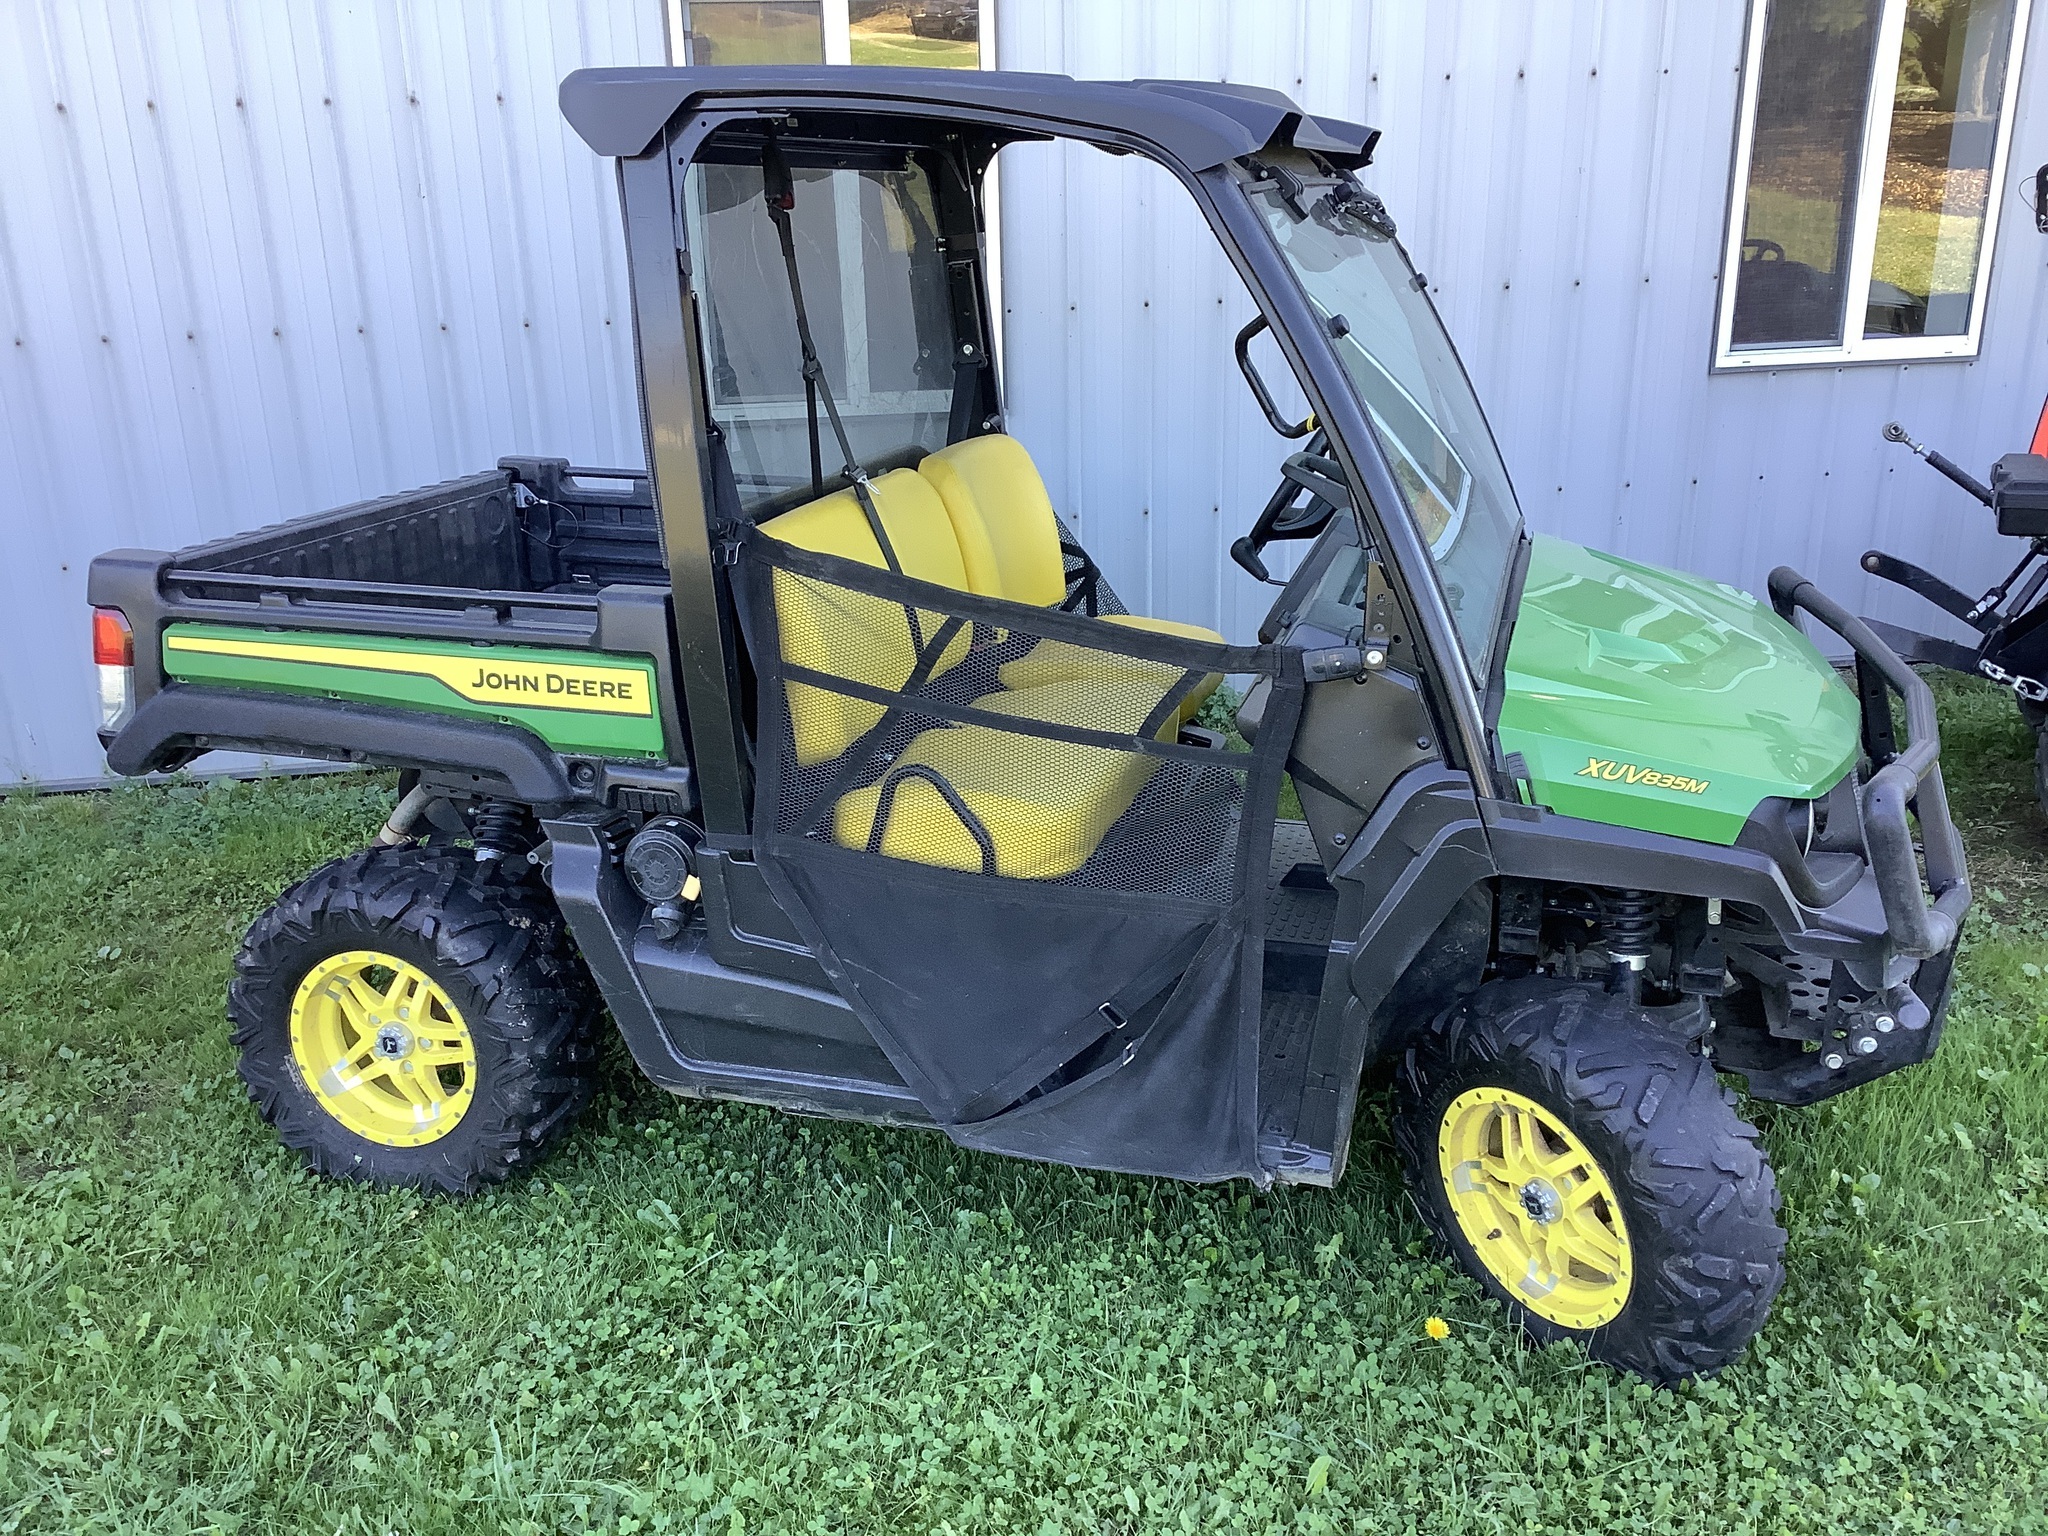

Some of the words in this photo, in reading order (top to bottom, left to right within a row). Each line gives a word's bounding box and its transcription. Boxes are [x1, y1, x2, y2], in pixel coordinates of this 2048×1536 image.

[472, 668, 539, 692] JOHN
[546, 673, 633, 700] DEERE
[1575, 757, 1711, 795] XUV835M
